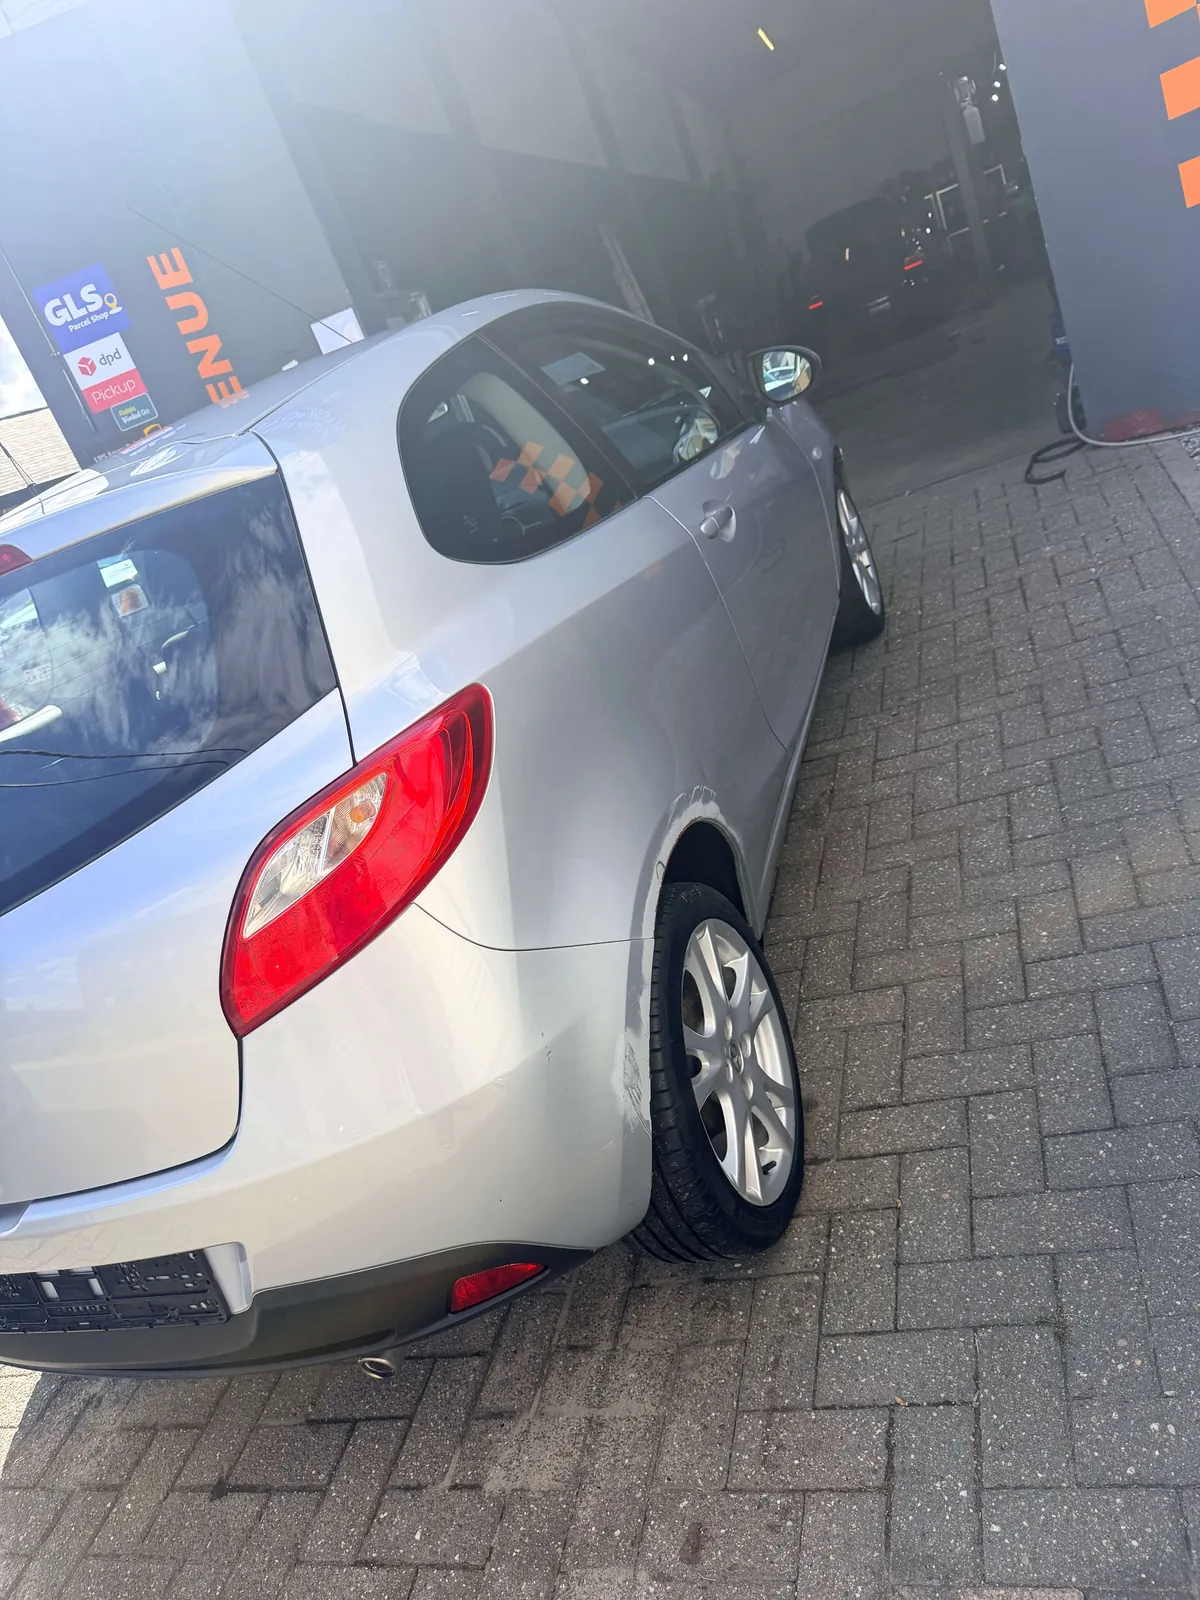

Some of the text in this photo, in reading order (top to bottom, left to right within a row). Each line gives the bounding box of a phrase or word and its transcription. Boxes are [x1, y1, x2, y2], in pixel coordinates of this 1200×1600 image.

[44, 283, 104, 327] GLS
[68, 311, 109, 332] Parcel Shop
[99, 348, 122, 366] dpd
[91, 379, 137, 404] Pickup
